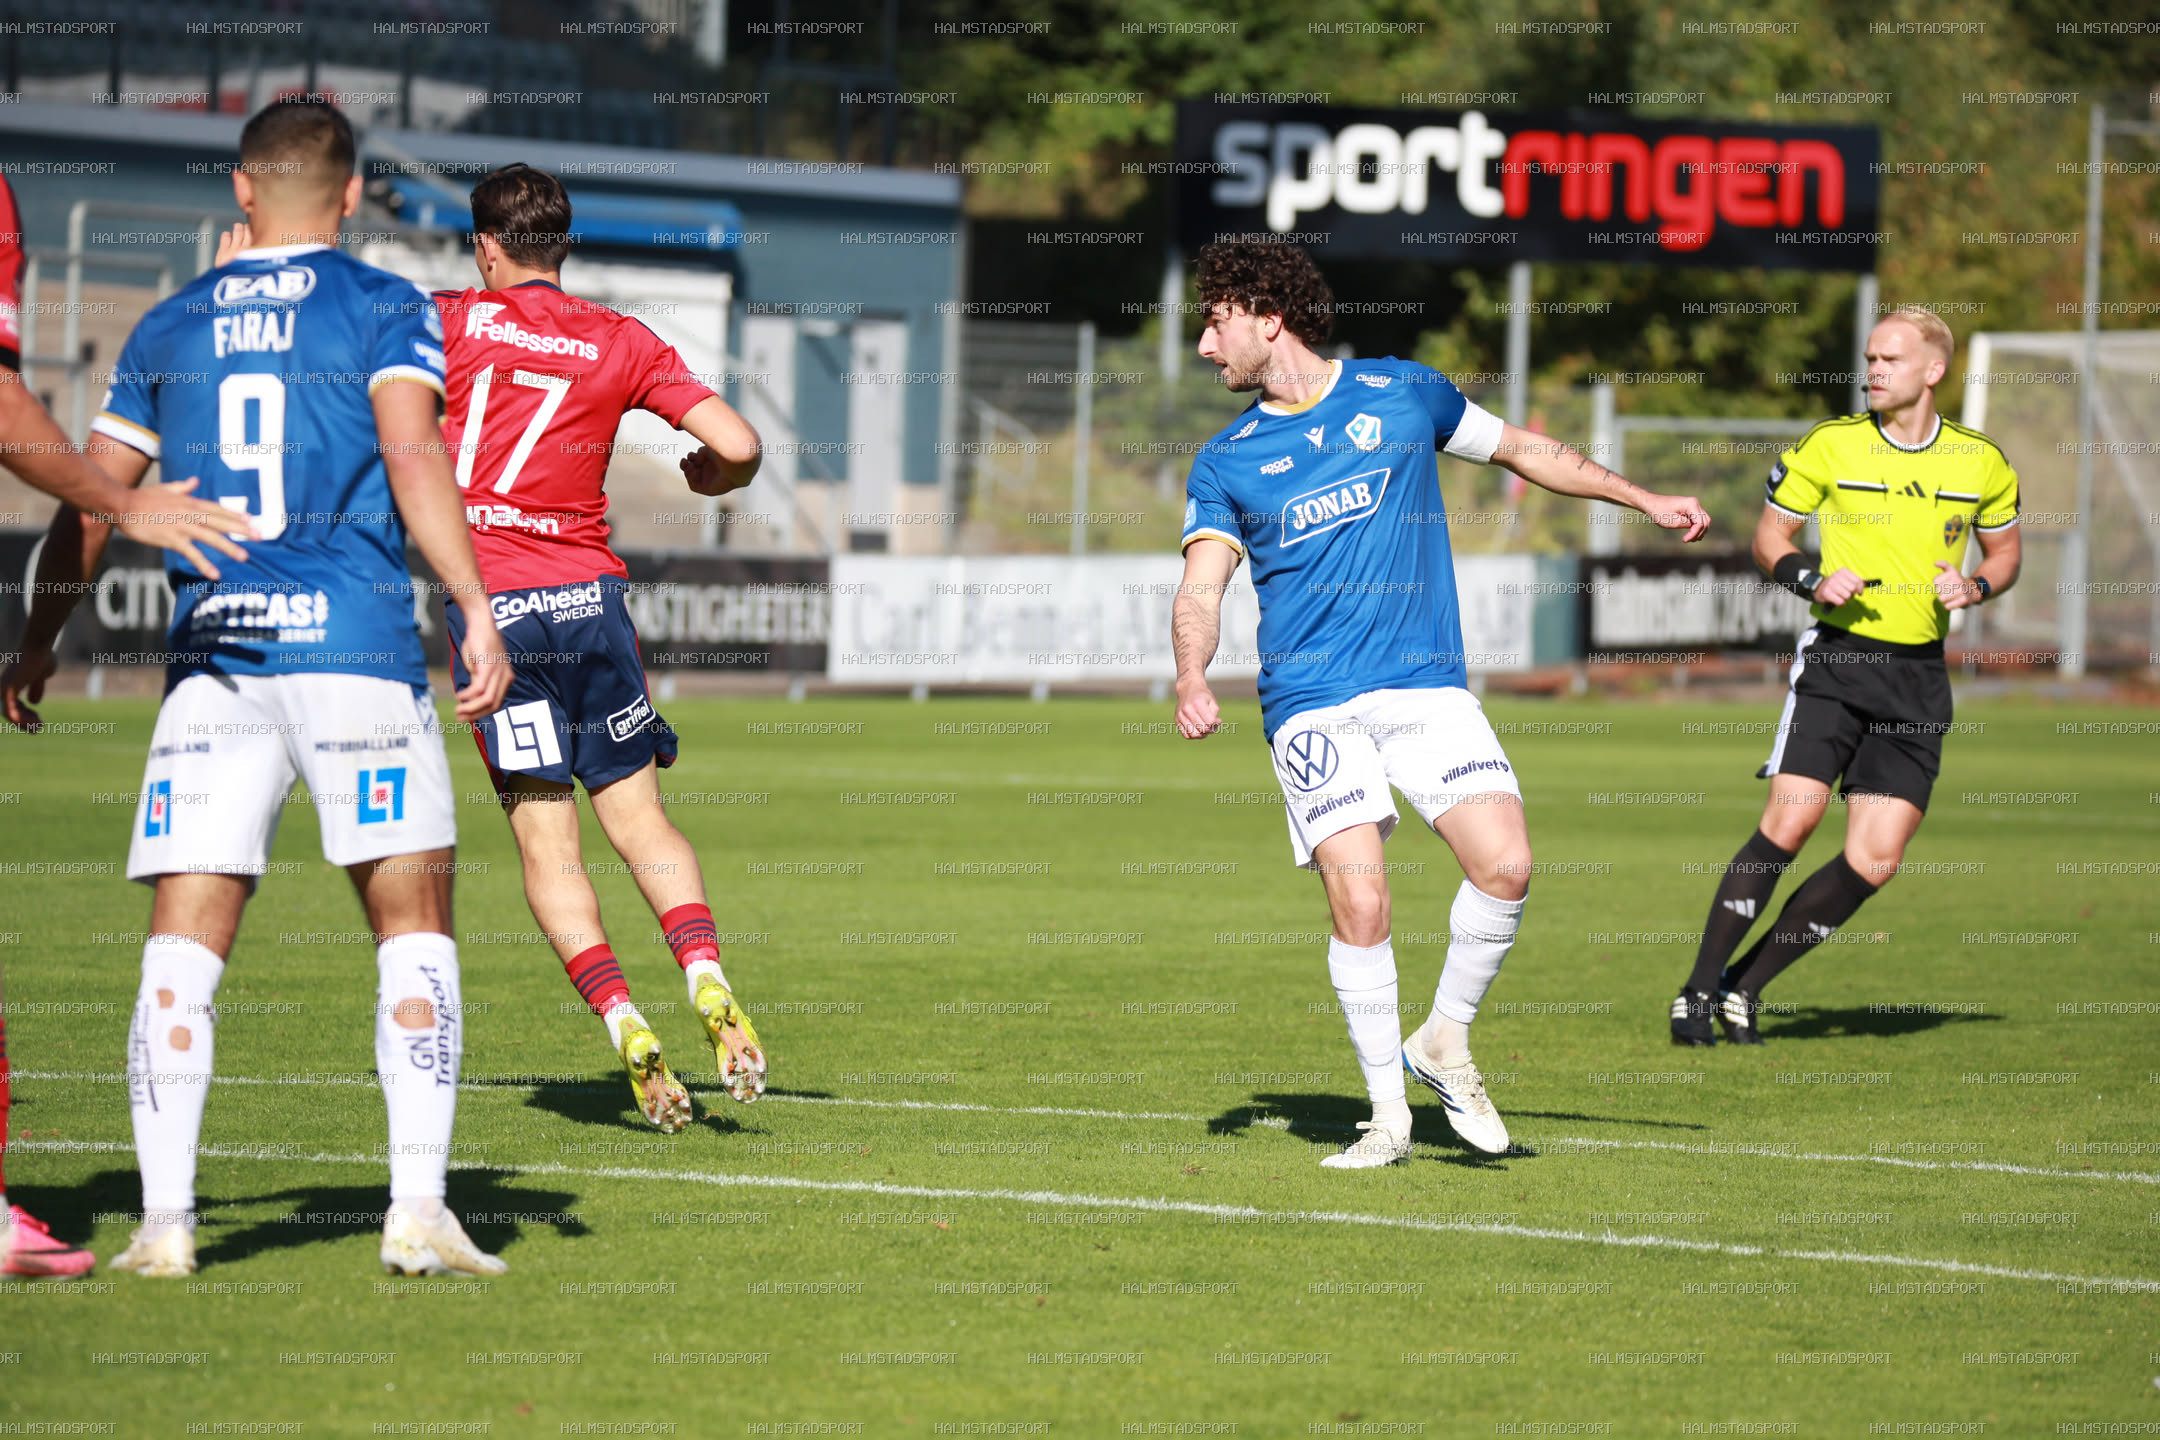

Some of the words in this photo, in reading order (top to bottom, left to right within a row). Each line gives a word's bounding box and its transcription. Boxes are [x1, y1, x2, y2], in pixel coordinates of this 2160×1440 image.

[1213, 110, 1845, 252] sportringen
[224, 270, 307, 301] EAB
[213, 310, 296, 358] FARAJ
[474, 318, 599, 361] Fellessons
[456, 363, 572, 495] 17
[219, 373, 287, 541] 9
[1292, 483, 1373, 531] JONAB
[491, 581, 602, 619] GoAhead
[552, 604, 604, 623] SWEDEN
[615, 702, 650, 736] griffel
[1442, 759, 1500, 784] villalivet
[1306, 790, 1358, 824] villalivet
[403, 1036, 434, 1070] GN
